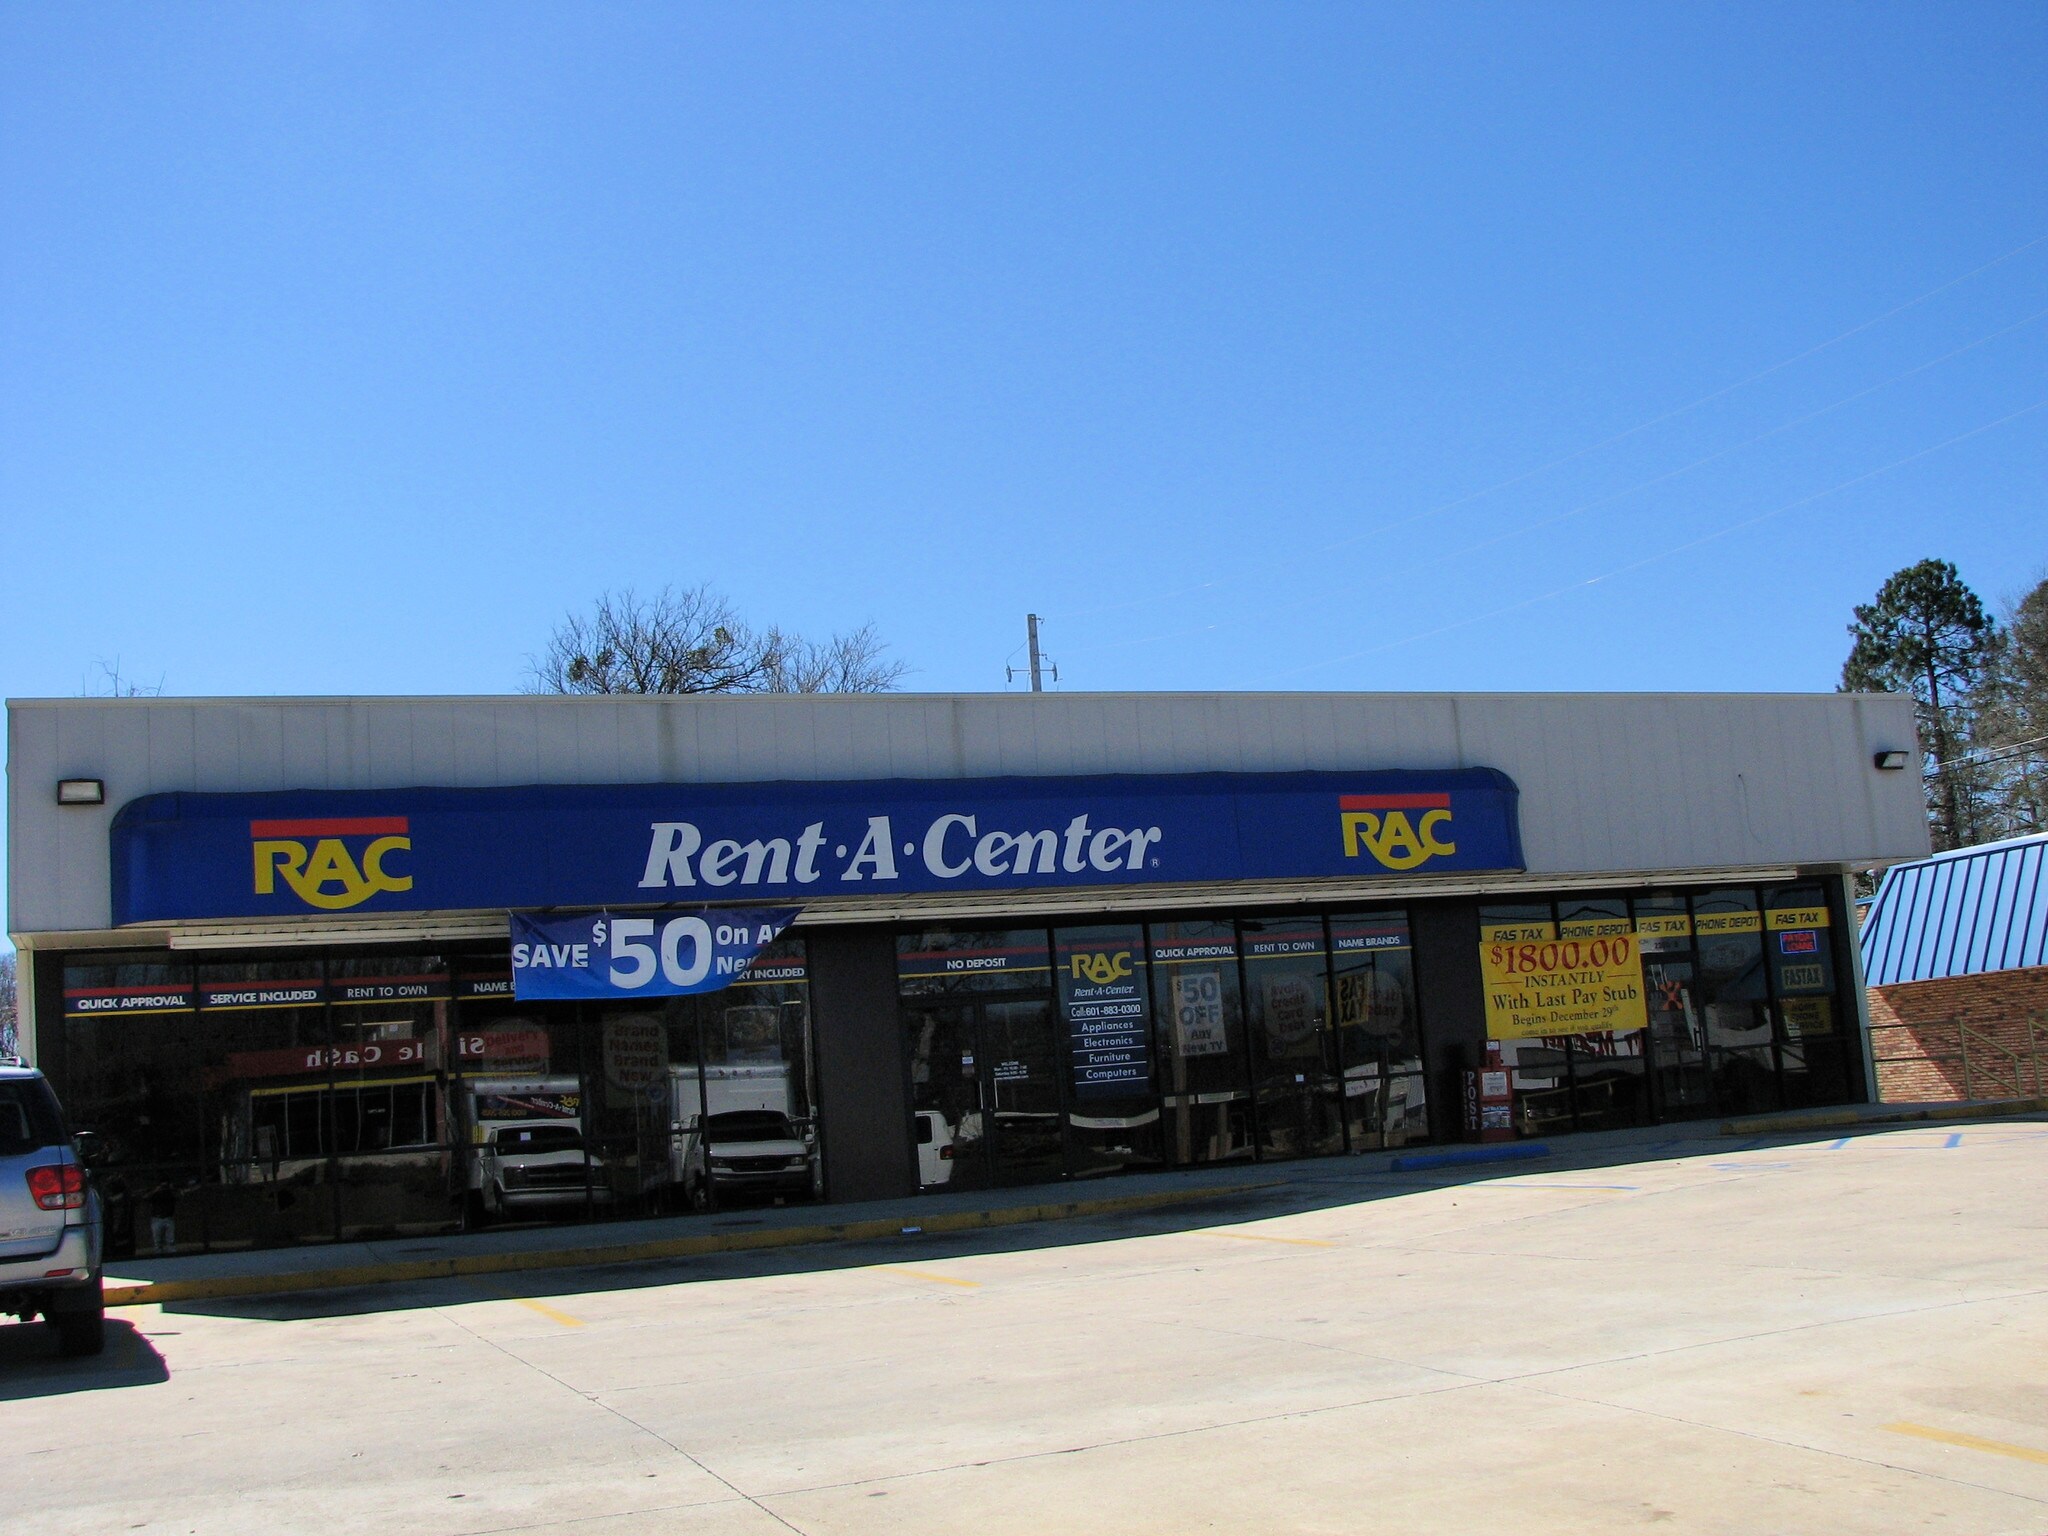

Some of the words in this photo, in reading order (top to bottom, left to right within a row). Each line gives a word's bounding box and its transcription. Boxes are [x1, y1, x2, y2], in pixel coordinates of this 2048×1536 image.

[1340, 809, 1456, 870] RAC
[253, 836, 413, 910] RAC
[1695, 918, 1726, 930] PHONE
[1729, 916, 1759, 928] DEPOT
[1776, 914, 1796, 924] FAS
[1800, 912, 1818, 922] TAX
[1560, 926, 1593, 938] PHONE
[1597, 923, 1630, 935] DEPOT
[1639, 921, 1661, 932] FAS
[1665, 920, 1685, 931] TAX
[715, 925, 749, 945] On
[1338, 938, 1364, 948] NAME
[1366, 936, 1401, 946] BRANDS
[1493, 930, 1517, 941] FAS
[1521, 929, 1543, 939] TAX
[513, 943, 589, 968] SAVE
[592, 916, 713, 989] $50
[1155, 948, 1185, 958] QUICK
[1187, 945, 1234, 957] APPROVAL
[1254, 943, 1275, 953] RENT
[1277, 942, 1289, 952] TO
[1292, 941, 1315, 951] OWN
[1491, 937, 1629, 973] $1800.00
[946, 960, 964, 969] NO
[966, 957, 1007, 968] DEPOSIT
[1071, 951, 1132, 984] RAC
[754, 967, 805, 979] INCLUDED
[1525, 970, 1605, 988] INSTANTLY
[1784, 967, 1820, 986] FASTAX
[347, 987, 374, 998] RENT
[379, 986, 394, 997] TO
[398, 985, 428, 996] OWN
[473, 981, 508, 993] NAME
[78, 997, 118, 1010] QUICK
[121, 995, 186, 1008] APPROVAL
[210, 992, 257, 1005] SERVICE
[259, 990, 317, 1002] INCLUDED
[1492, 993, 1529, 1010] With
[1536, 991, 1566, 1008] Last
[1572, 988, 1598, 1005] Pay
[1603, 984, 1637, 1001] Stub
[1179, 1004, 1219, 1025] OFF
[1512, 1013, 1546, 1027] Begins
[1550, 1009, 1599, 1023] December
[1081, 1021, 1134, 1033] Appliances
[1083, 1035, 1133, 1048] Electronics
[1089, 1053, 1131, 1063] Furniture
[1086, 1068, 1137, 1079] Computers
[1467, 1071, 1478, 1130] POST
